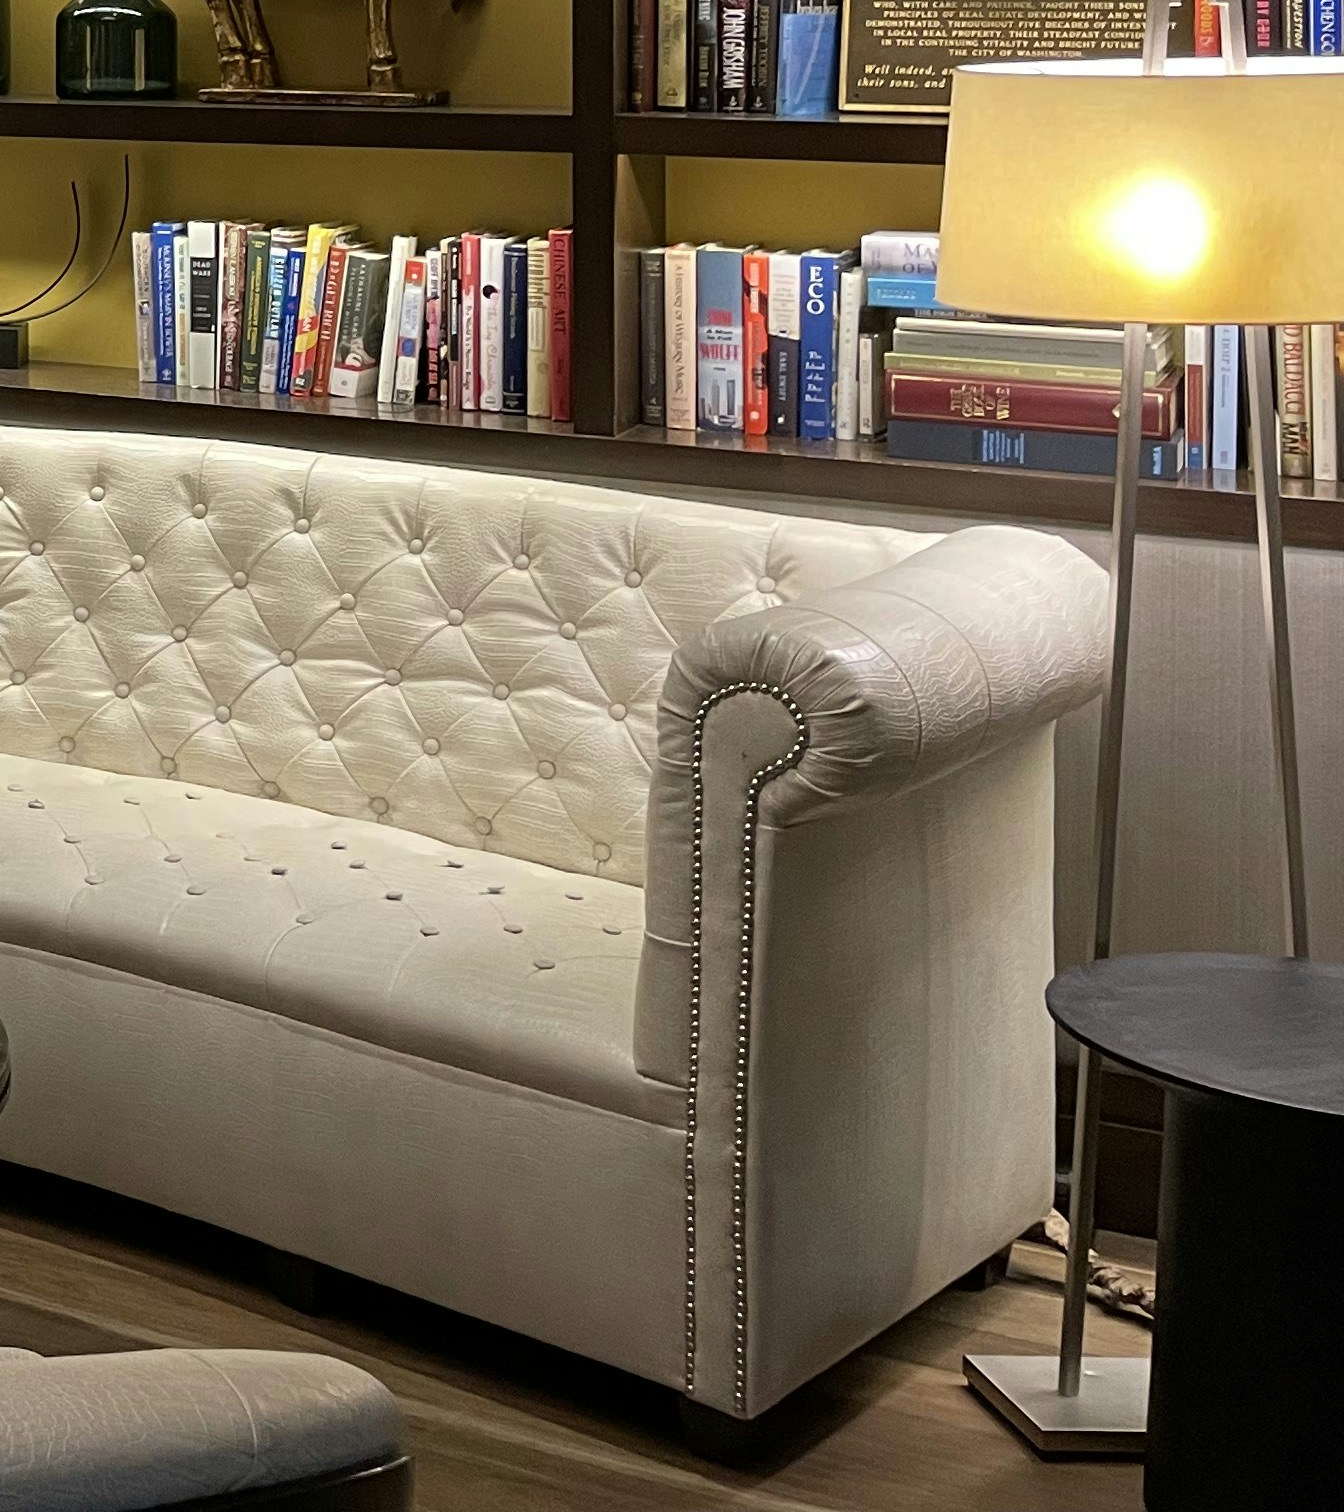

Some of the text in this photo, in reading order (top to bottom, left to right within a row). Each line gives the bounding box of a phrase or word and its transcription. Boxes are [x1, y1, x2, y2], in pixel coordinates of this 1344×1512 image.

[882, 10, 939, 19] PRINCIPLES
[941, 10, 956, 19] OF
[958, 10, 984, 19] REAL
[987, 11, 1025, 19] ESTATE
[1027, 11, 1104, 21] DEVELOPMENT,
[1106, 11, 1130, 20] AND
[902, 1, 1145, 10] WITH CARE AND TAUGHT THEIR SONS
[759, 5, 771, 44] JEFFREY
[872, 29, 1101, 39] IN LOCAL REAL THEIR STEADFAST
[947, 20, 1107, 29] THROUGHOUT FIVE DECADES OF
[1255, 18, 1270, 48] DOOR
[722, 7, 746, 89] JOHN GRISHAM
[880, 38, 1141, 49] IN THE CONTINUING VITALITY AND BRIGHT FUTURE
[948, 48, 1083, 58] THE CITY OF WASHINGTON
[757, 48, 769, 88] TOOBIN
[863, 64, 890, 75] Well
[893, 64, 936, 77] indeed,
[856, 76, 947, 89] their and
[192, 261, 211, 269] DEAD
[192, 269, 211, 277] WAKE
[902, 262, 929, 275] OF
[554, 238, 567, 336] CHINESE ART
[808, 265, 825, 316] ECO
[269, 258, 285, 339] CITIZEN OUTLAW
[464, 315, 472, 335] World
[673, 272, 685, 394] HISTORY OF WESTERN MUSIC
[700, 343, 739, 360] WOLFE
[778, 351, 788, 401] EARL SWIFT
[1283, 343, 1305, 416] BALDACCI
[950, 388, 962, 411] THE
[996, 386, 1011, 421] WINE
[1281, 422, 1301, 455] MAN
